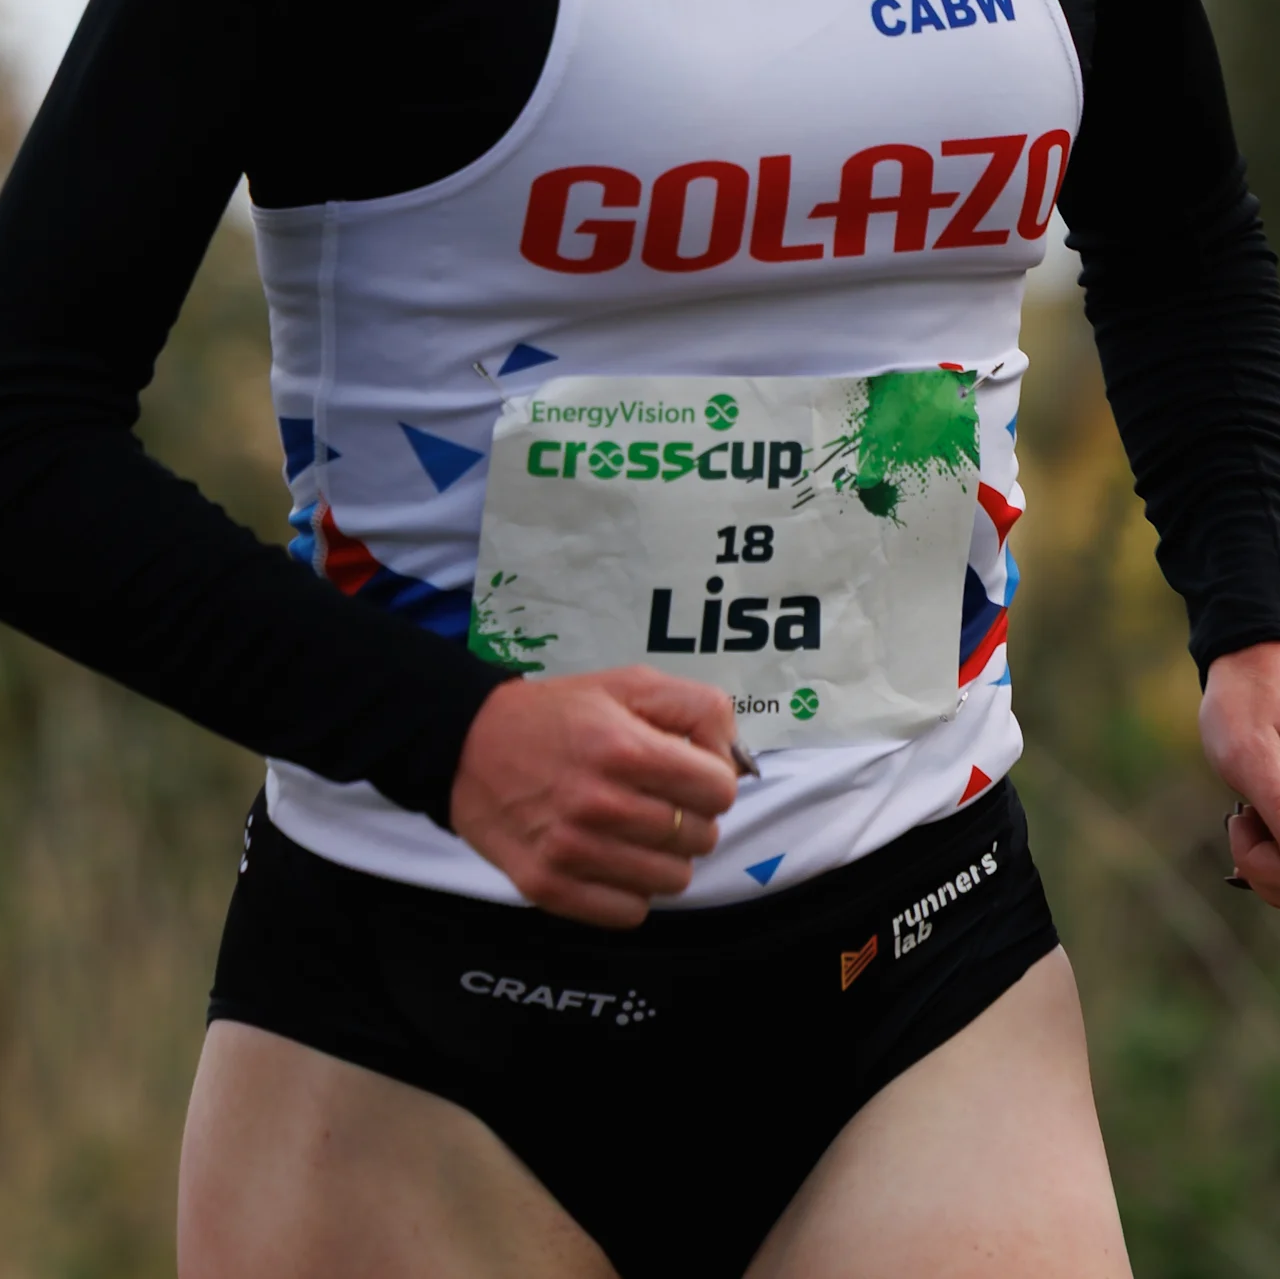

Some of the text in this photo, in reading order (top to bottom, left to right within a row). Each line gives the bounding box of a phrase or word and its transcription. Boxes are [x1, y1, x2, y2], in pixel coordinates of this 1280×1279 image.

[520, 129, 1071, 274] GOLAZO
[531, 400, 696, 428] EnergyVision
[715, 524, 775, 565] 18
[646, 576, 822, 654] Lisa
[893, 919, 933, 960] lab
[459, 970, 617, 1018] CRAFT
